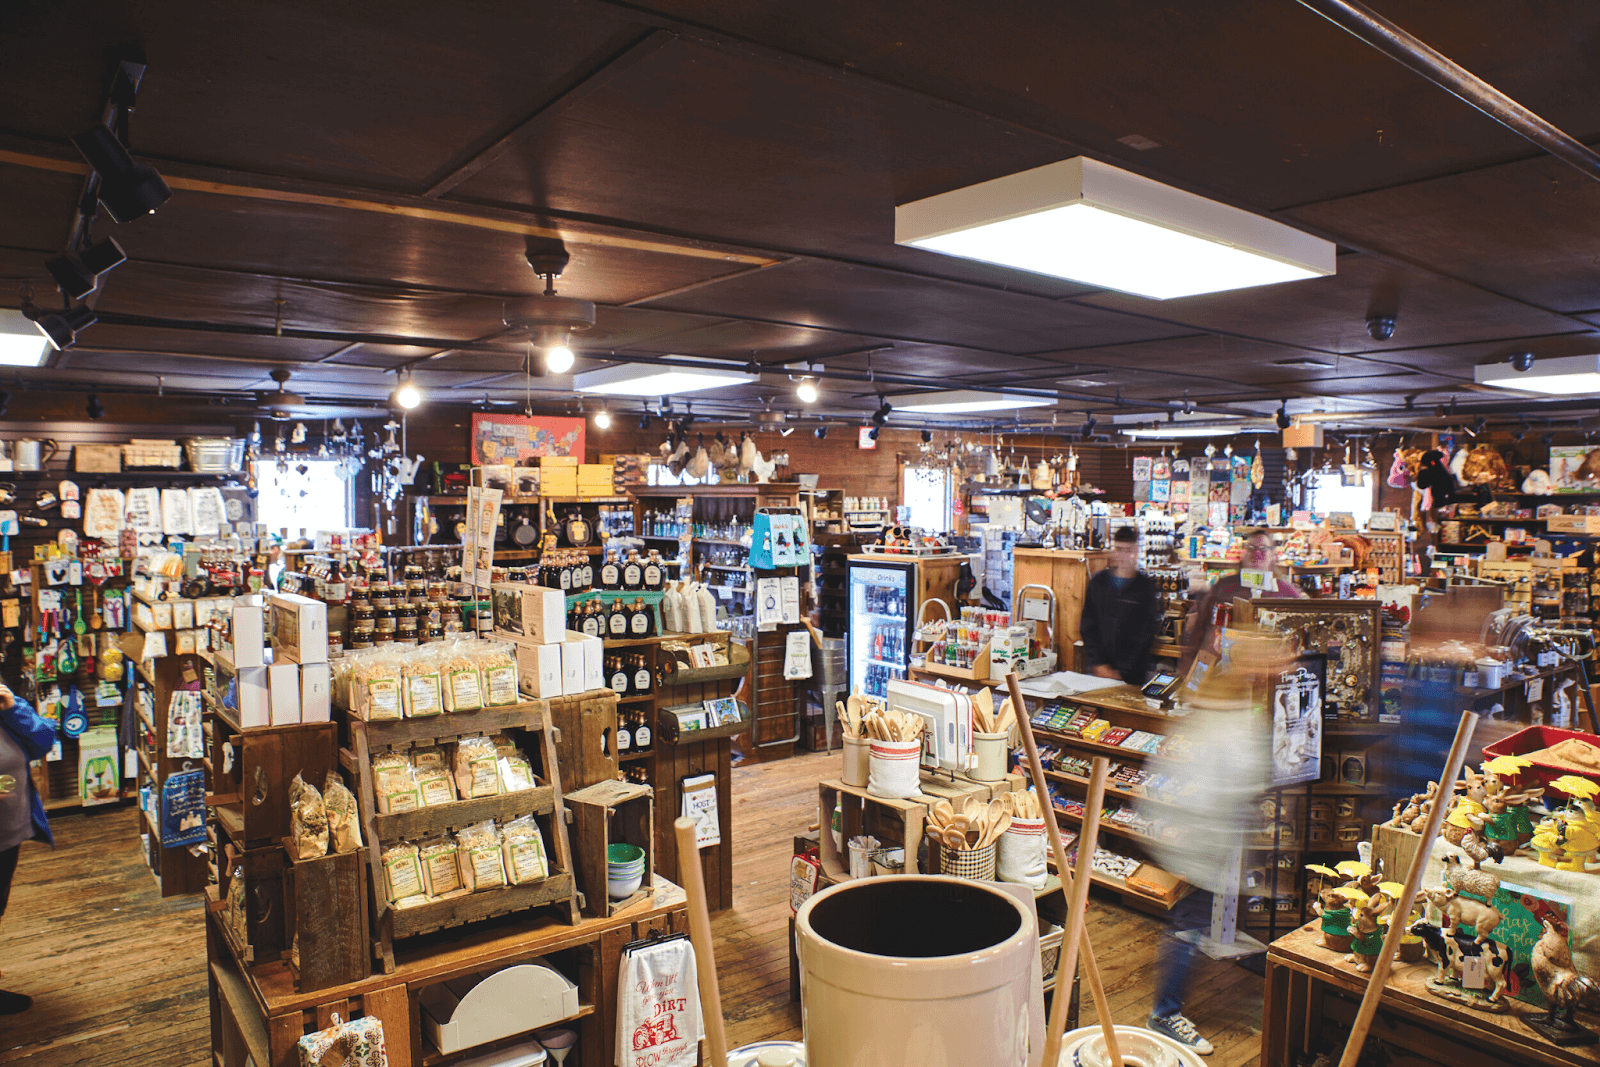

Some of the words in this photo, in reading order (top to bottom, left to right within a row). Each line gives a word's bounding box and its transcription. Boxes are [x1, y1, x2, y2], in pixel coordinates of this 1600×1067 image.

[877, 574, 895, 582] Drinks
[693, 799, 709, 809] HOST
[1501, 908, 1533, 933] has
[636, 980, 663, 994] When
[657, 988, 674, 1001] you
